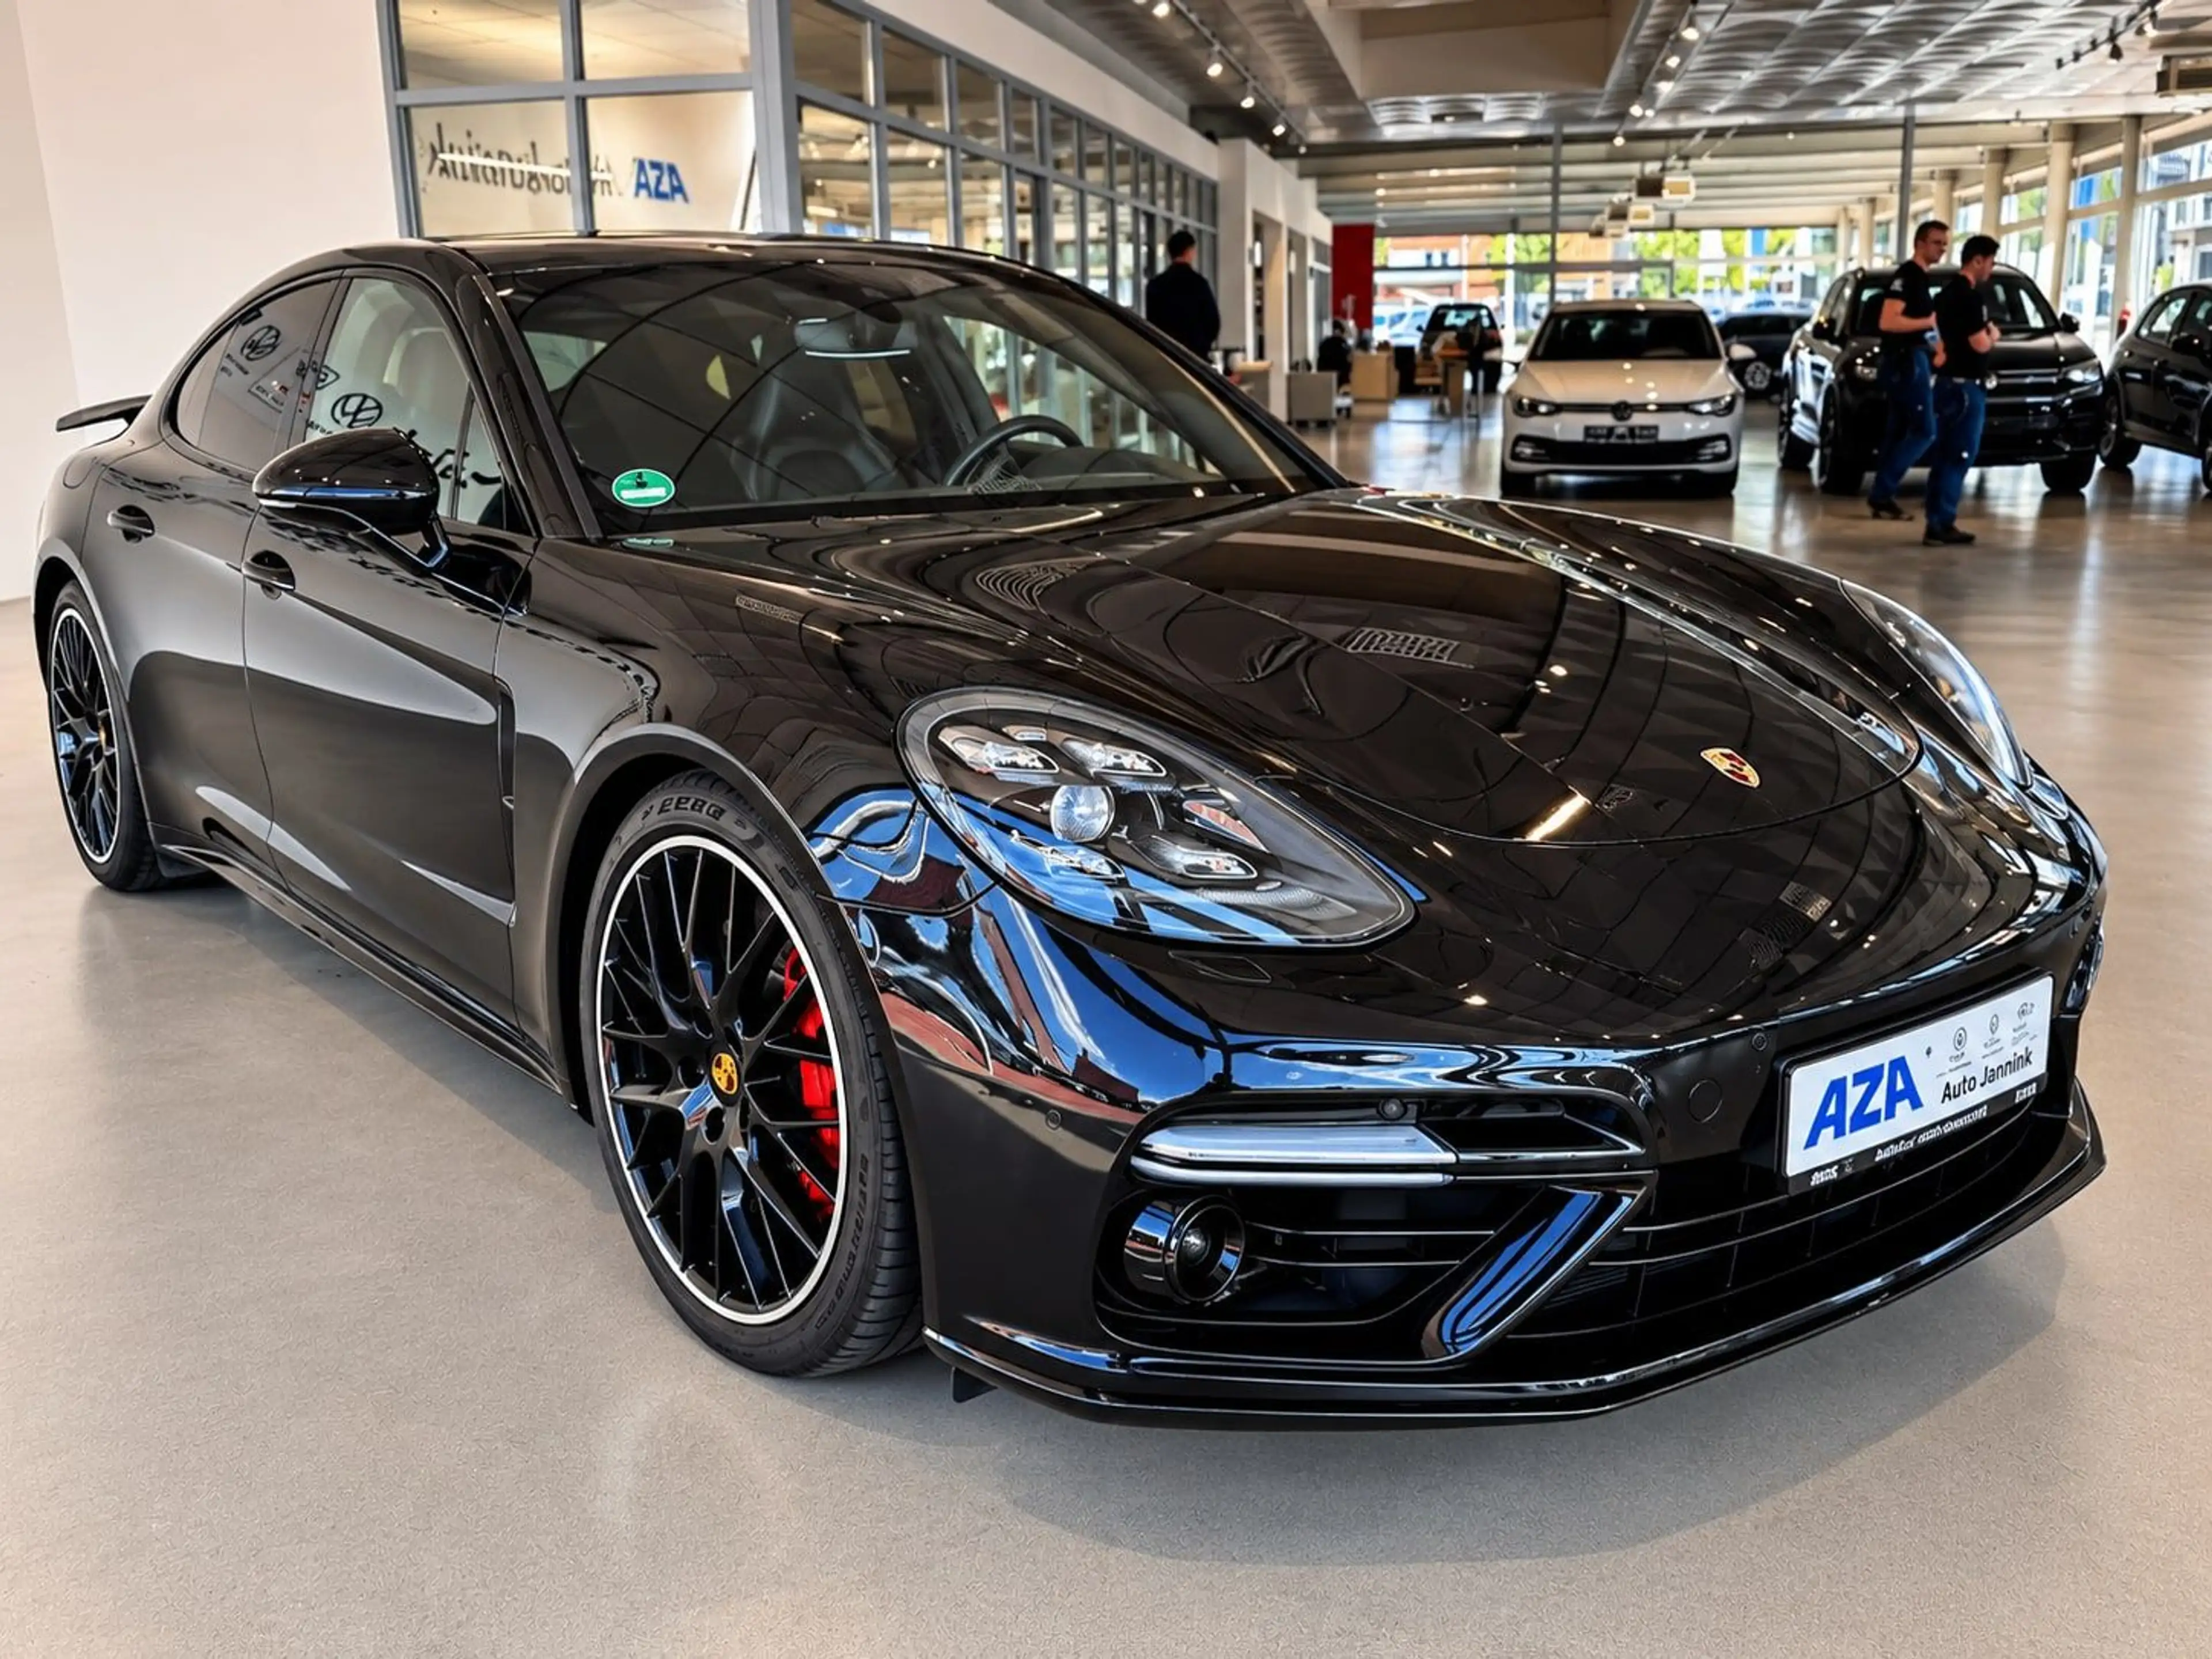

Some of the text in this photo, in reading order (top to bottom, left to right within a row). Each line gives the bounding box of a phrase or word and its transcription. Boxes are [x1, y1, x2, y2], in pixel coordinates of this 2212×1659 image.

[634, 158, 690, 204] AZA
[1804, 1055, 1923, 1150] AZA
[1941, 1075, 1976, 1104] Auto
[1979, 1046, 2033, 1088] Jannink
